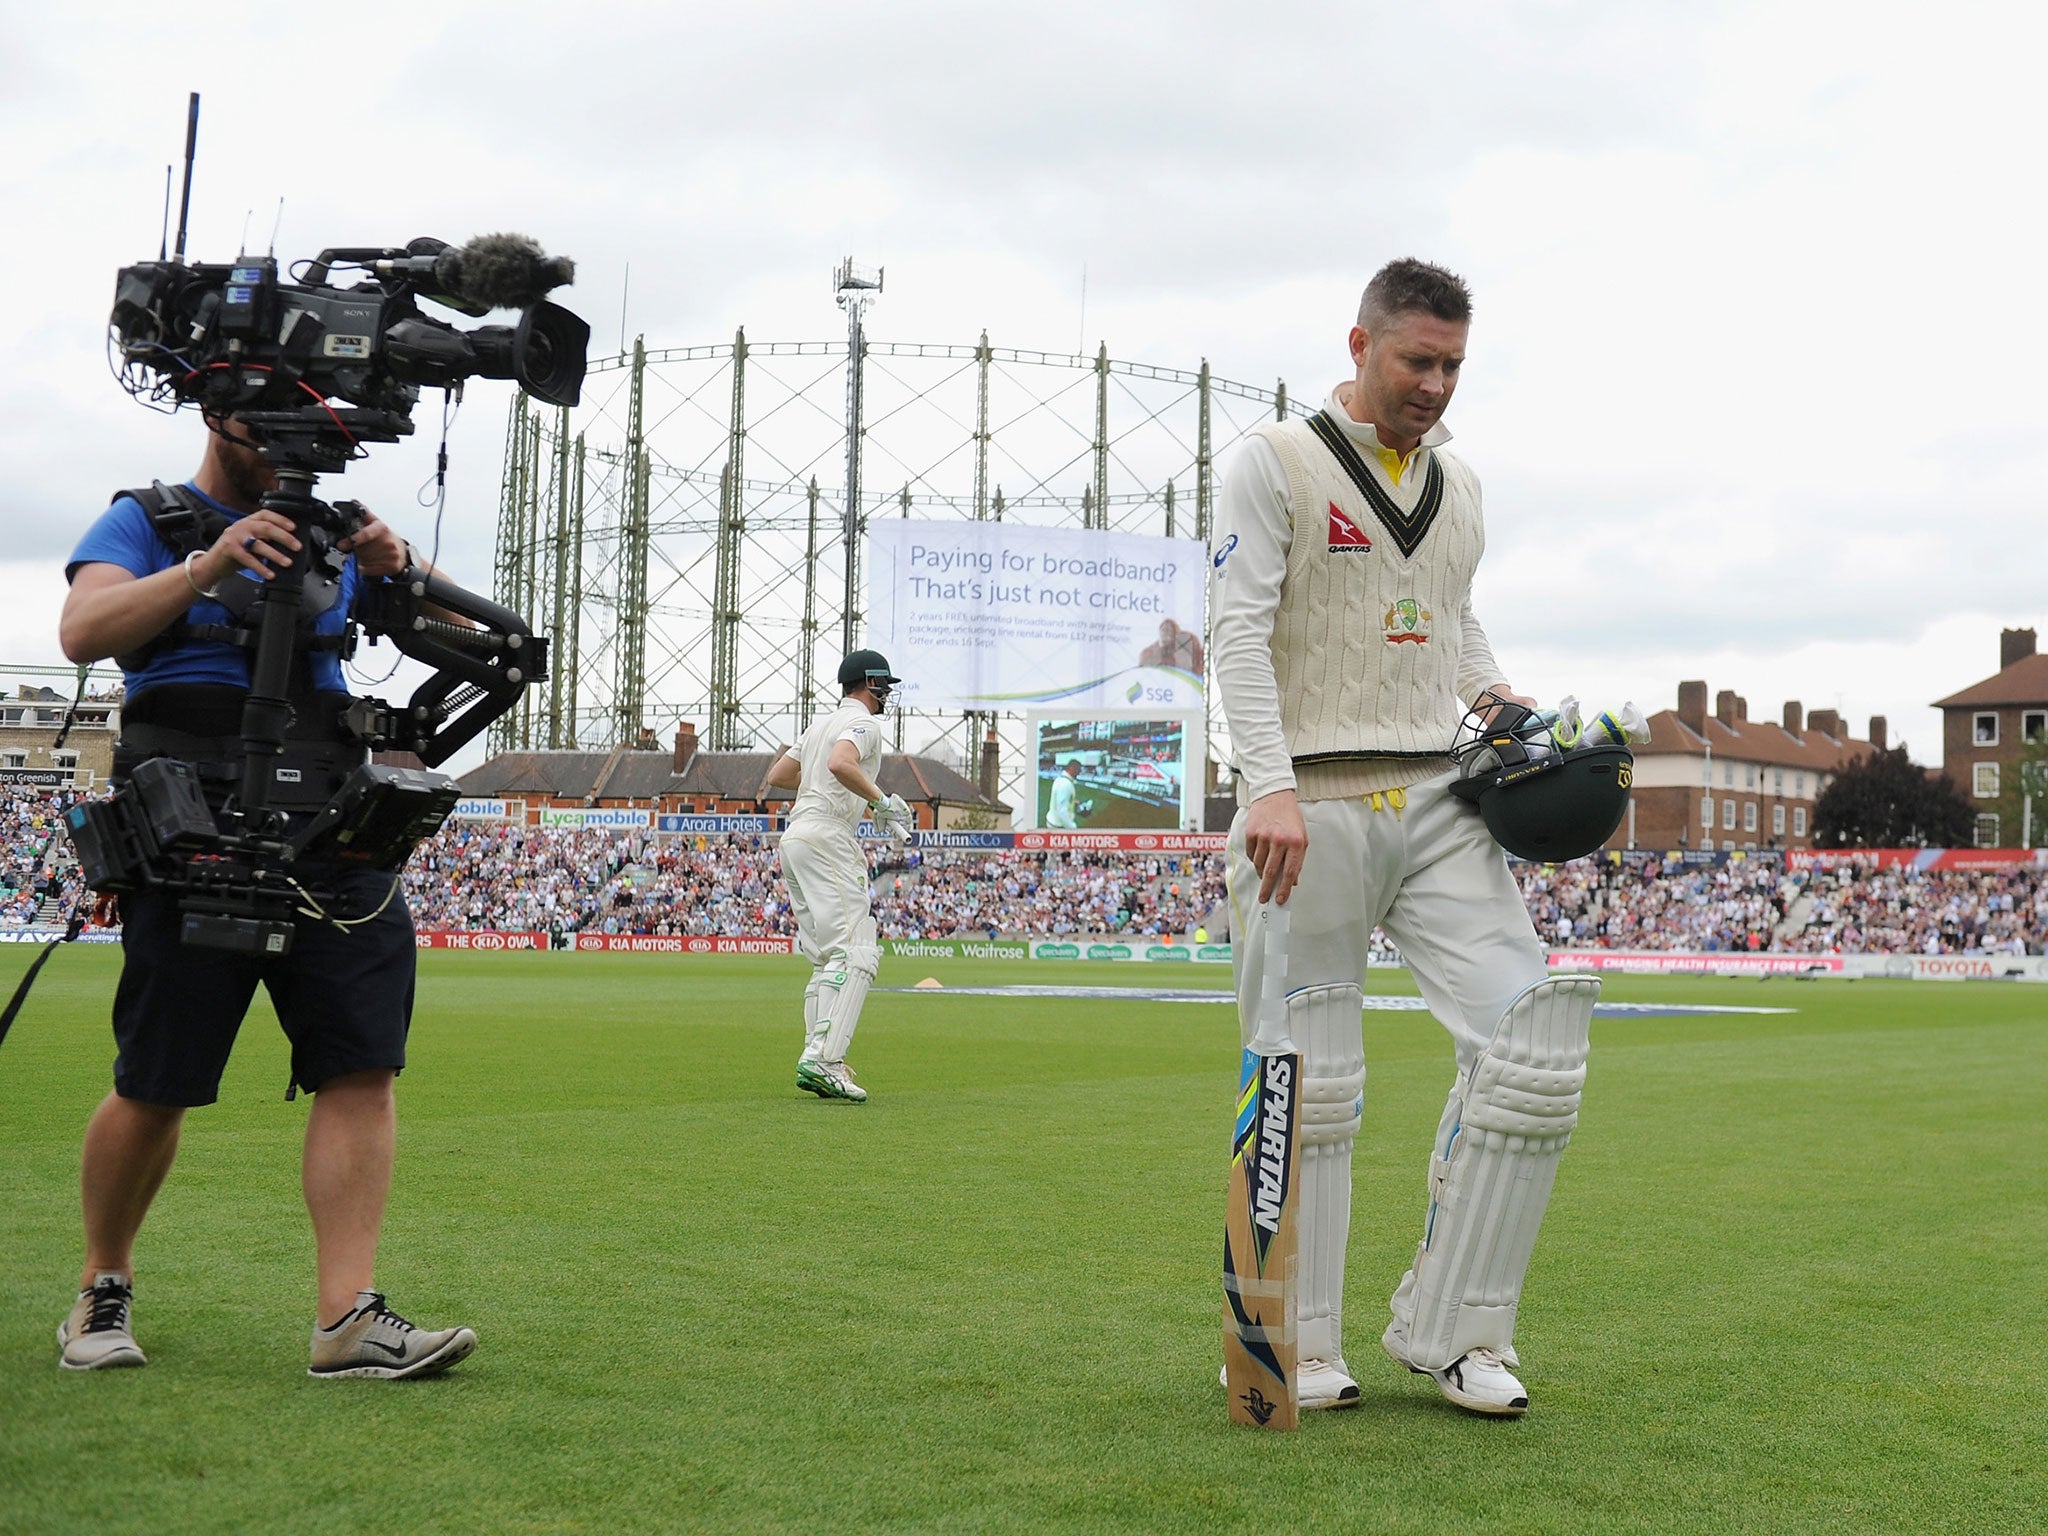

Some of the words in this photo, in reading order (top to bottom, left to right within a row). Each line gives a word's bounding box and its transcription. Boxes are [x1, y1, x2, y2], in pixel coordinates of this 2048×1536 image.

[1328, 545, 1371, 554] QANTAS
[911, 545, 992, 574] Paying
[1002, 549, 1035, 571] for
[1043, 553, 1177, 583] broadband?
[909, 577, 982, 600] That's
[987, 580, 1031, 606] just
[1040, 588, 1081, 606] not
[1089, 589, 1165, 614] cricket.
[918, 612, 943, 622] years
[970, 612, 1012, 624] unlimited
[1014, 616, 1065, 627] broadband
[1067, 619, 1087, 629] with
[908, 635, 933, 646] Offer
[936, 637, 959, 647] ends
[954, 626, 996, 638] including
[998, 627, 1014, 637] line
[1016, 629, 1042, 639] rental
[1045, 630, 1067, 640] from
[1089, 634, 1105, 644] per
[1146, 687, 1174, 702] sse
[16, 773, 57, 783] Greenish
[454, 801, 503, 815] obile
[542, 808, 648, 826] Lycamobile
[681, 817, 716, 831] Arora
[720, 816, 763, 831] Hotels
[1050, 835, 1070, 848] KIA
[1071, 836, 1119, 848] MOTORS
[1163, 836, 1183, 848] KIA
[1184, 837, 1227, 849] MOTOR
[445, 935, 470, 948] THE
[508, 936, 538, 949] OVAL
[609, 938, 628, 951] KIA
[631, 939, 682, 952] MOTORS
[717, 940, 737, 953] KIA
[740, 941, 789, 954] MOTORS
[892, 942, 954, 957] Waitrose
[961, 943, 1024, 959] Waitrose
[1602, 958, 1654, 970] CHANGING
[1658, 959, 1704, 971] HEALTH
[1706, 960, 1770, 972] INSURANCE
[1773, 961, 1796, 972] FOR
[1918, 959, 1994, 976] TOYOTA
[1255, 1056, 1292, 1234] SPARTAN
